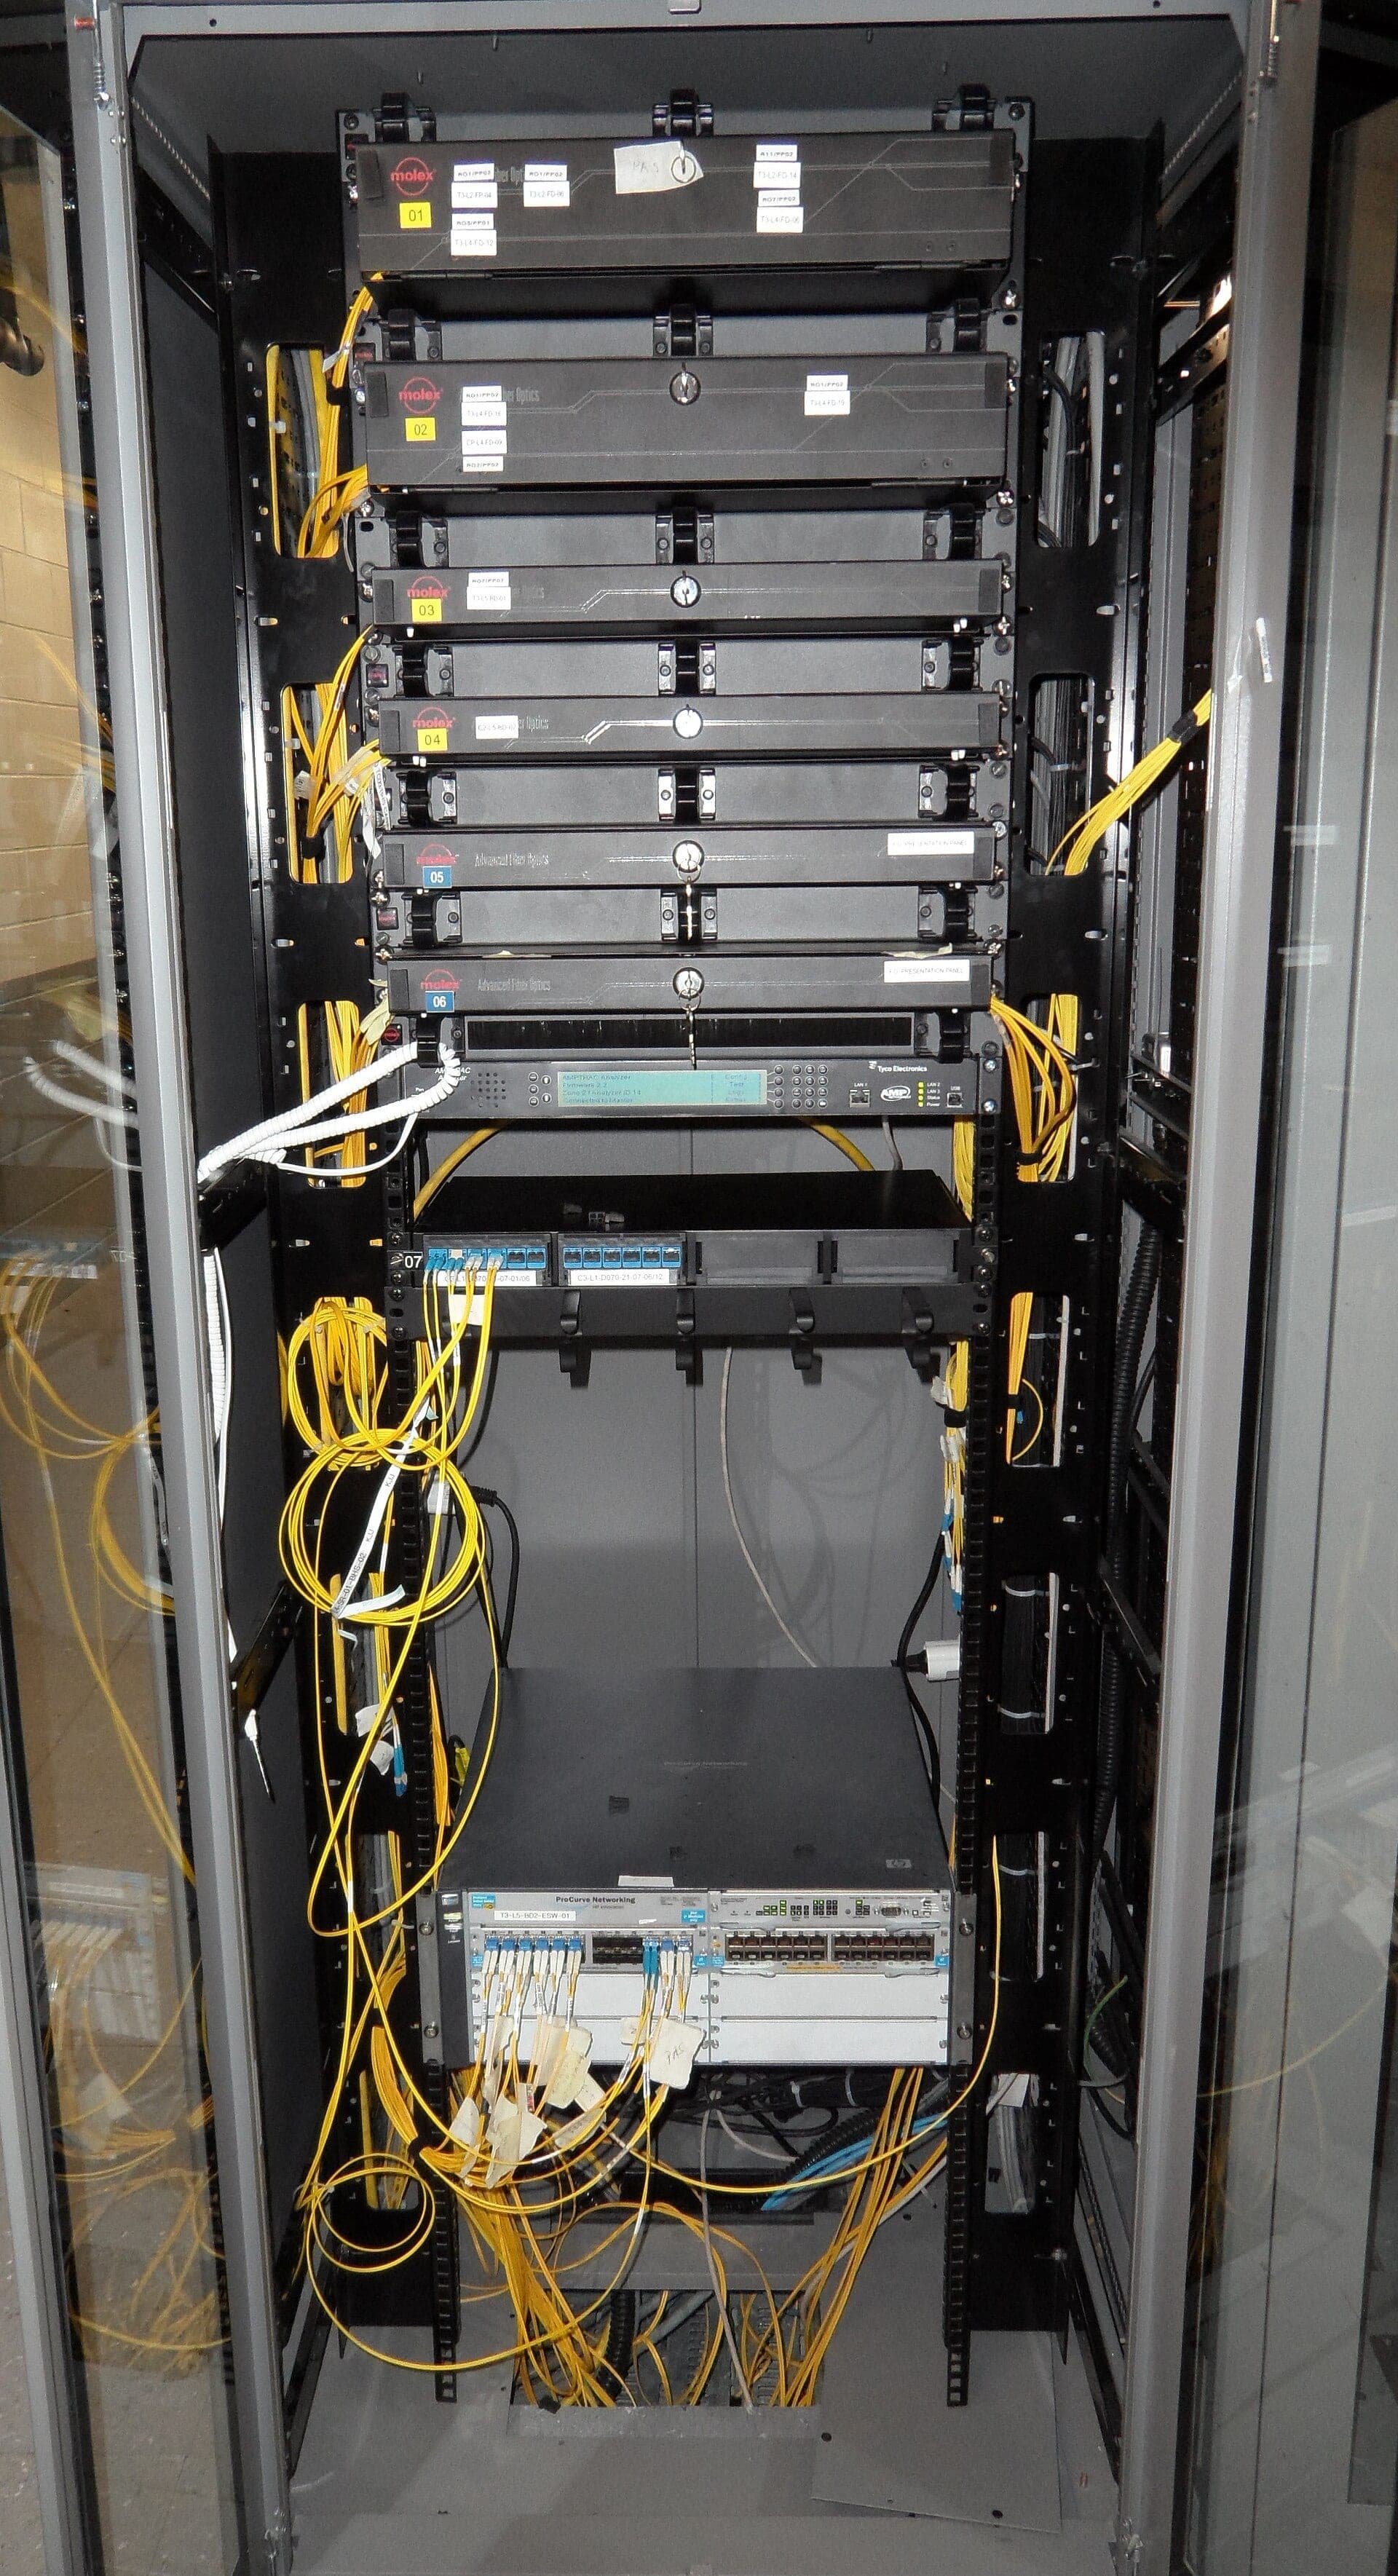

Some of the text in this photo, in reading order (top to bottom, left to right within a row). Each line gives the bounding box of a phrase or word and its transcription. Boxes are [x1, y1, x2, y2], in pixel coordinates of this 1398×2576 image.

[390, 167, 433, 183] molex
[408, 208, 424, 223] 01
[398, 388, 441, 402] molex
[414, 424, 428, 436] 02
[419, 604, 435, 617] 03
[424, 734, 441, 747] 04
[430, 871, 444, 883] 05
[433, 996, 446, 1008] 06
[882, 1089, 908, 1097] AMP
[404, 1255, 423, 1268] 07
[556, 1895, 636, 1905] ProCurve Networking
